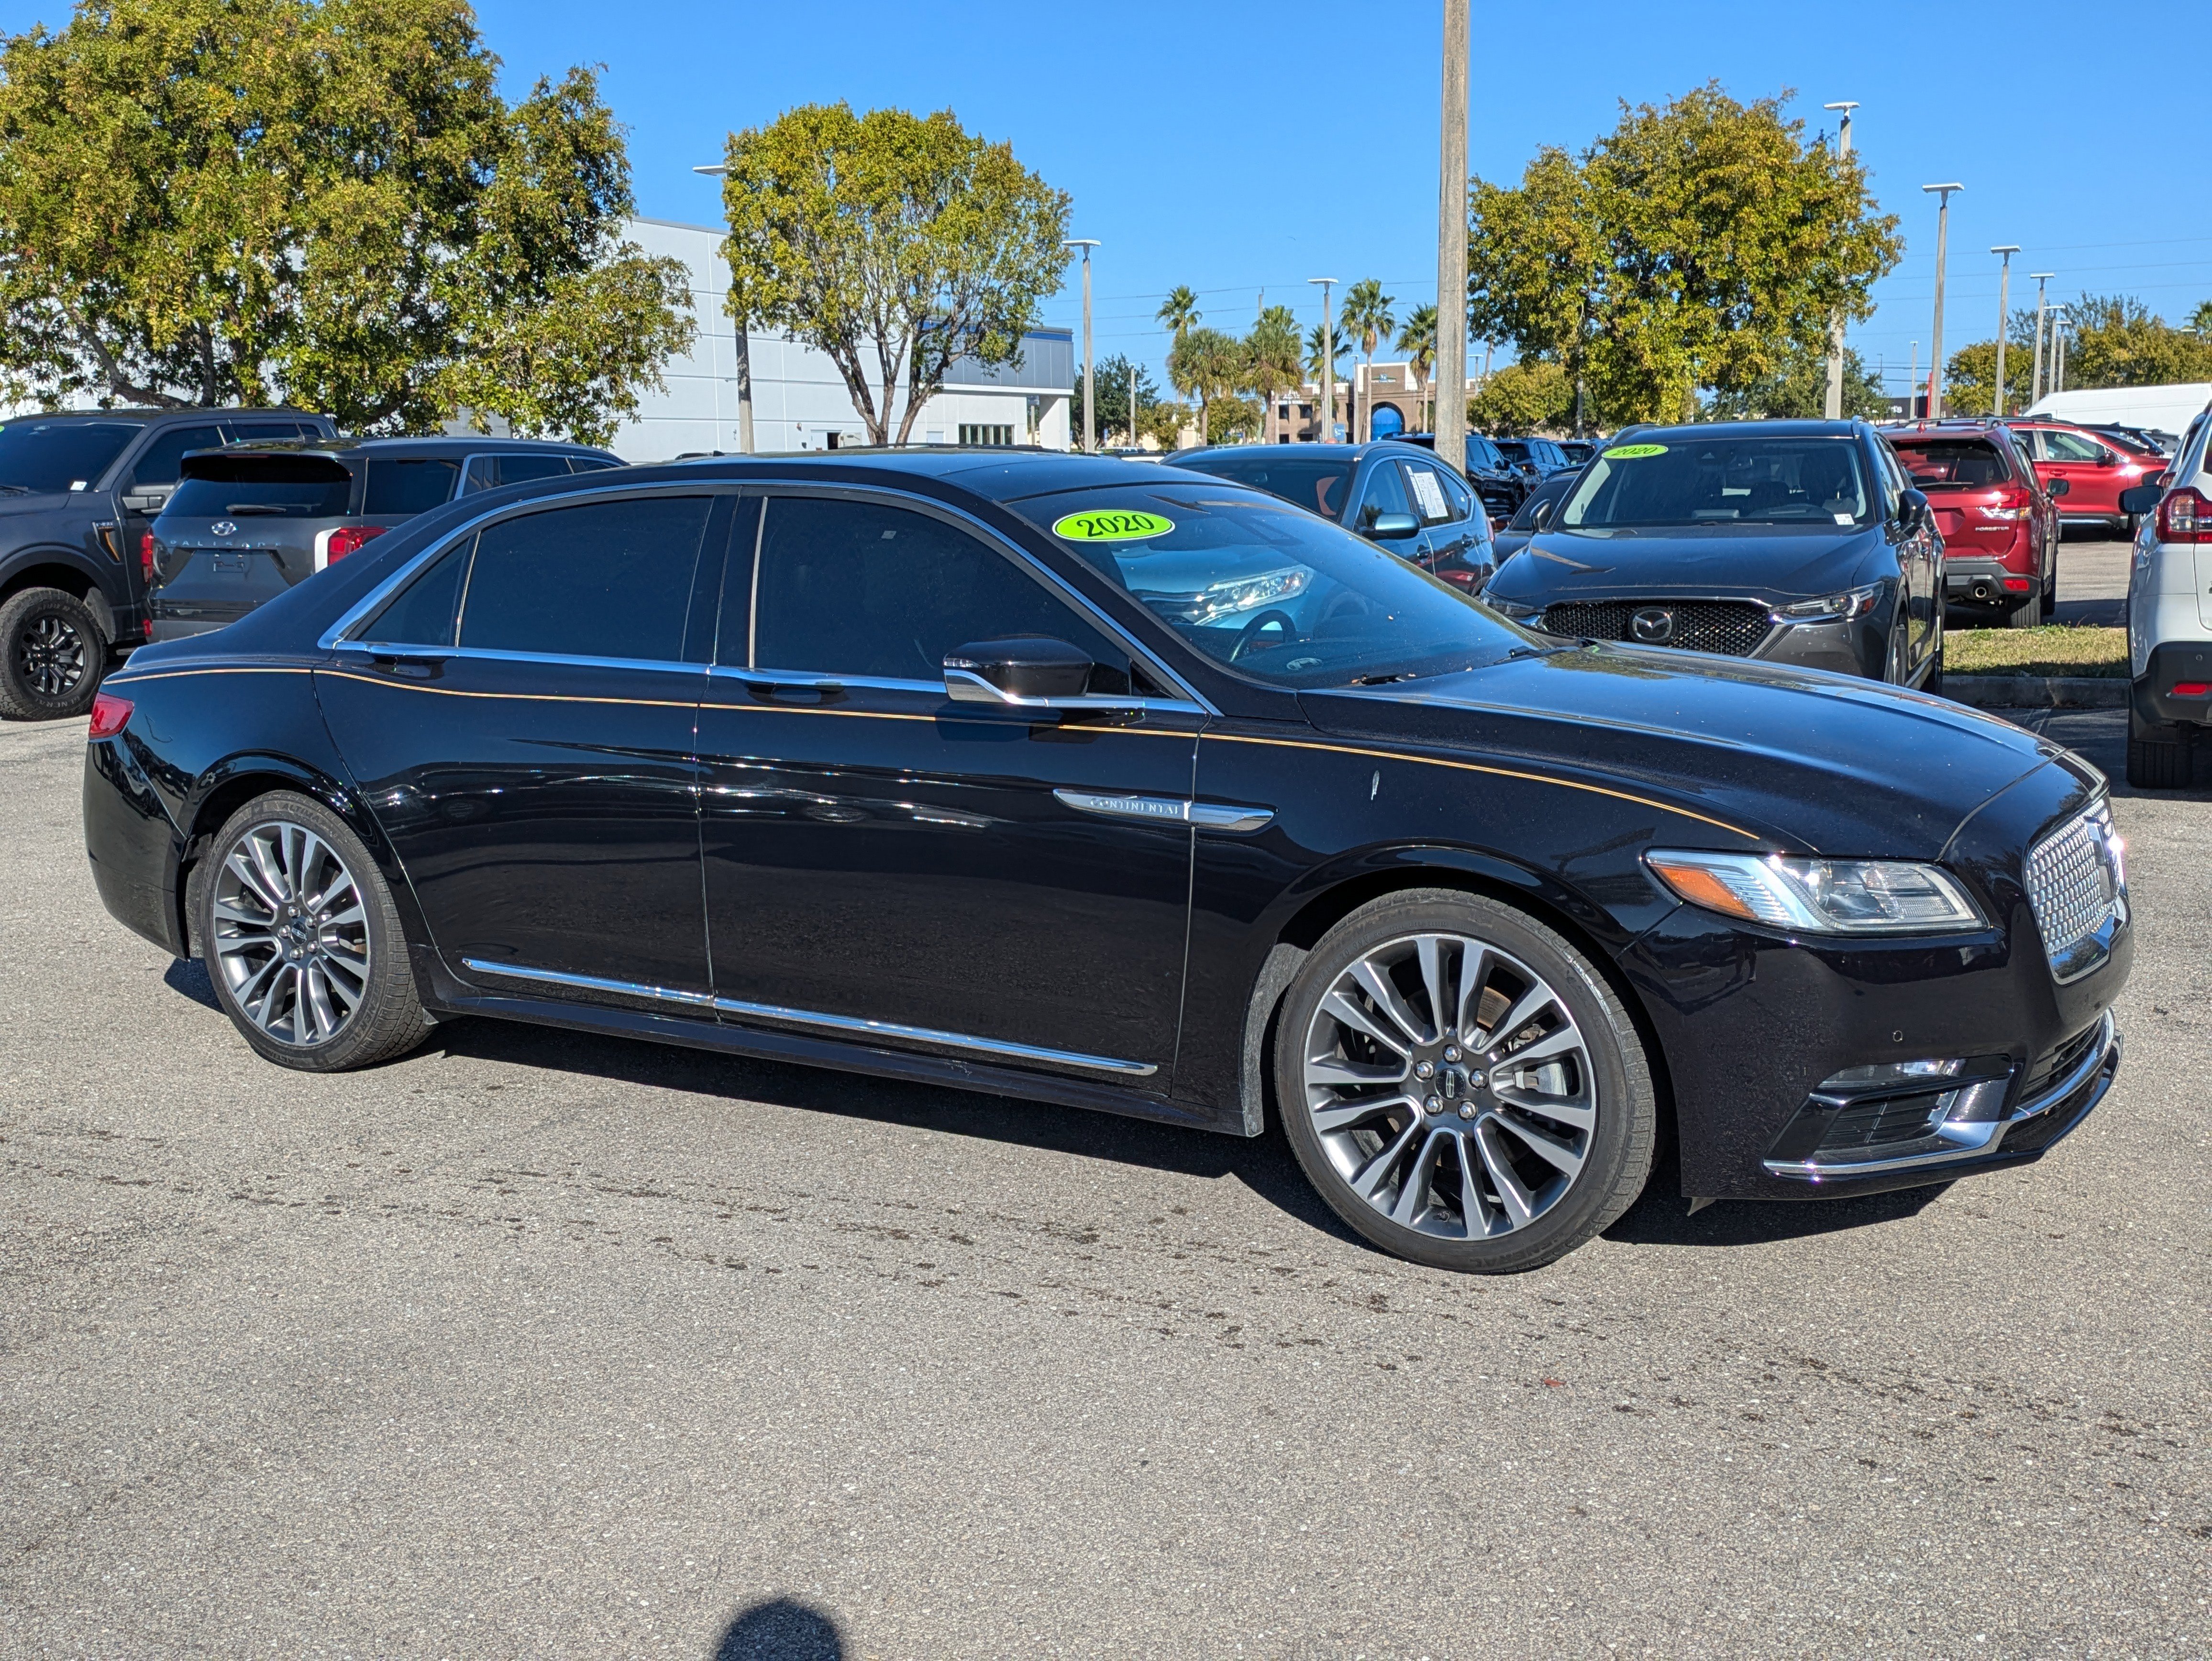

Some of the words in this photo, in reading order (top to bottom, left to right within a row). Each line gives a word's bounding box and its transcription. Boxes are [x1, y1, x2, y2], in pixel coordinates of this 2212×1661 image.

[1610, 447, 1658, 456] 2020
[1076, 514, 1155, 537] 2020
[1090, 797, 1181, 814] CONTINENTAL
